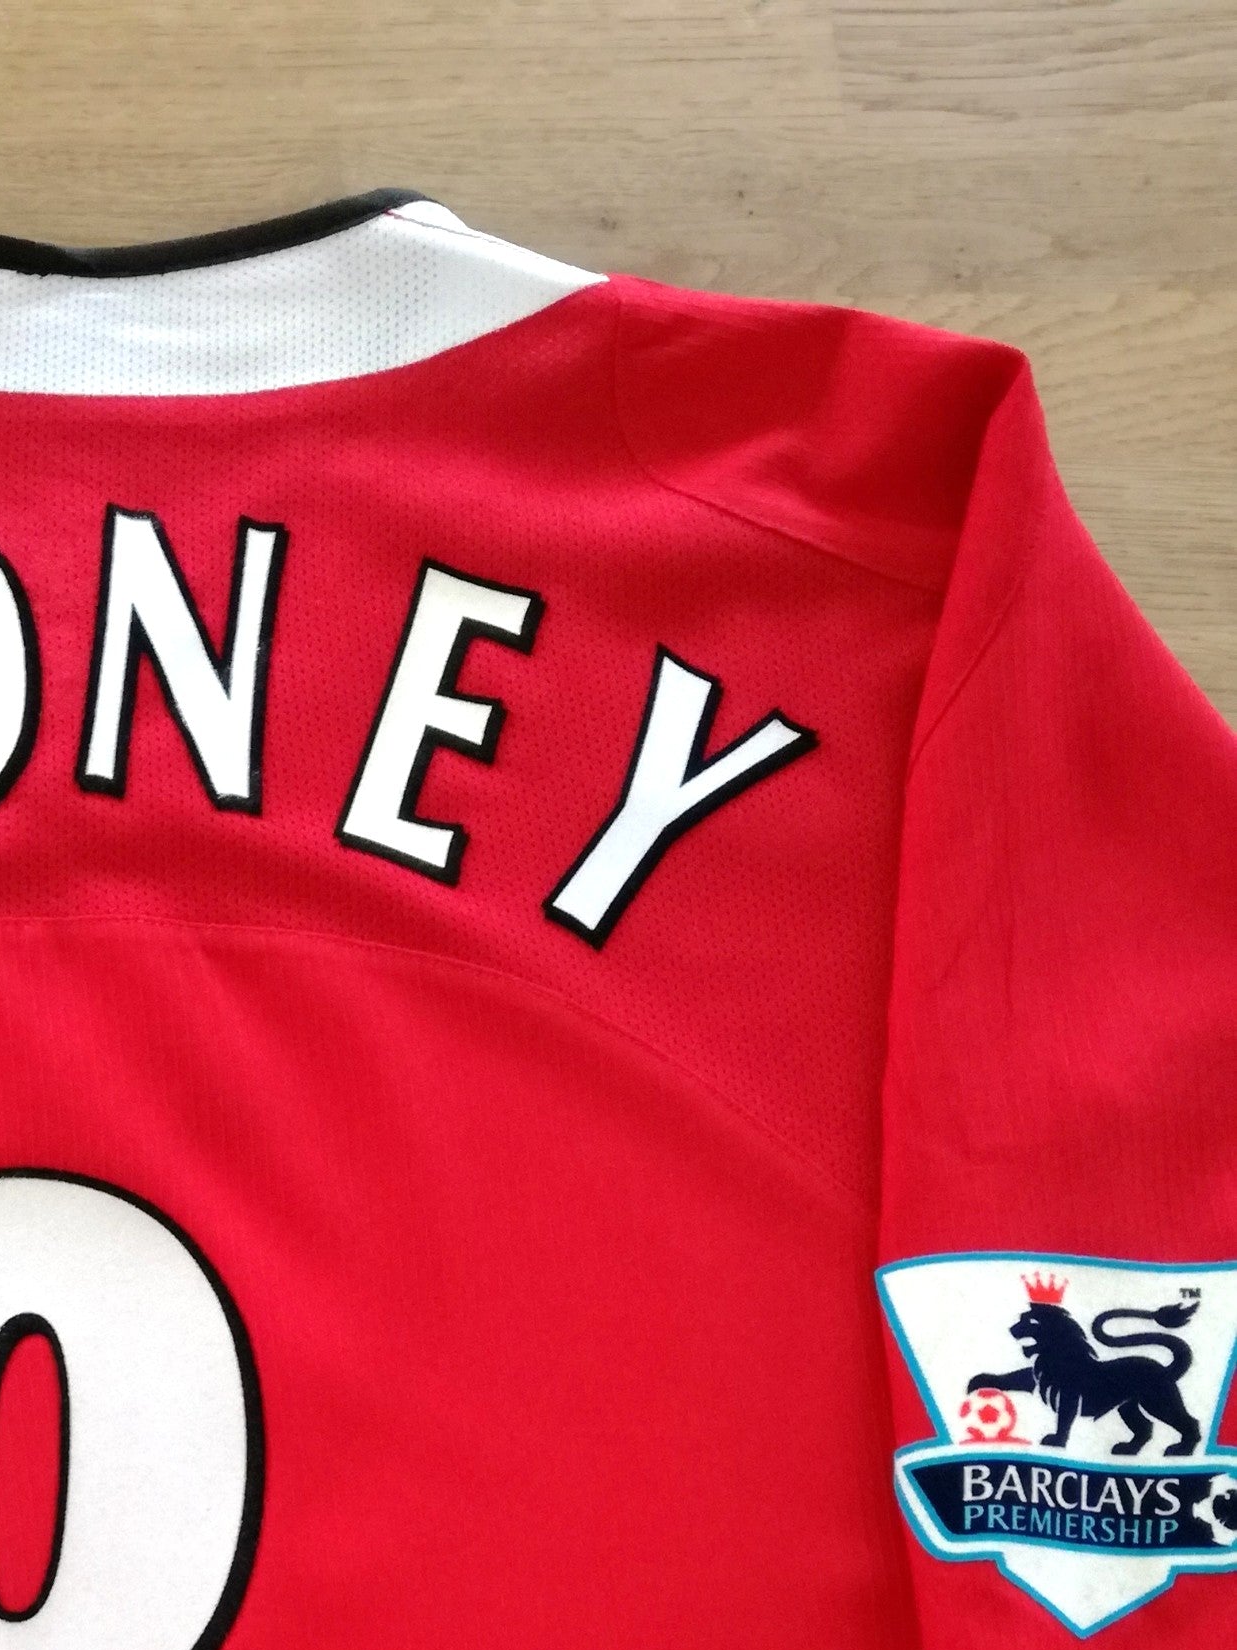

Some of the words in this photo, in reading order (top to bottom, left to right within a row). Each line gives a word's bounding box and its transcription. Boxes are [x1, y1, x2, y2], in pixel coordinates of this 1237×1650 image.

[1180, 1288, 1202, 1299] TM
[962, 1464, 1180, 1517] BARCLAYS
[964, 1504, 1179, 1544] PREMIERSHIP
